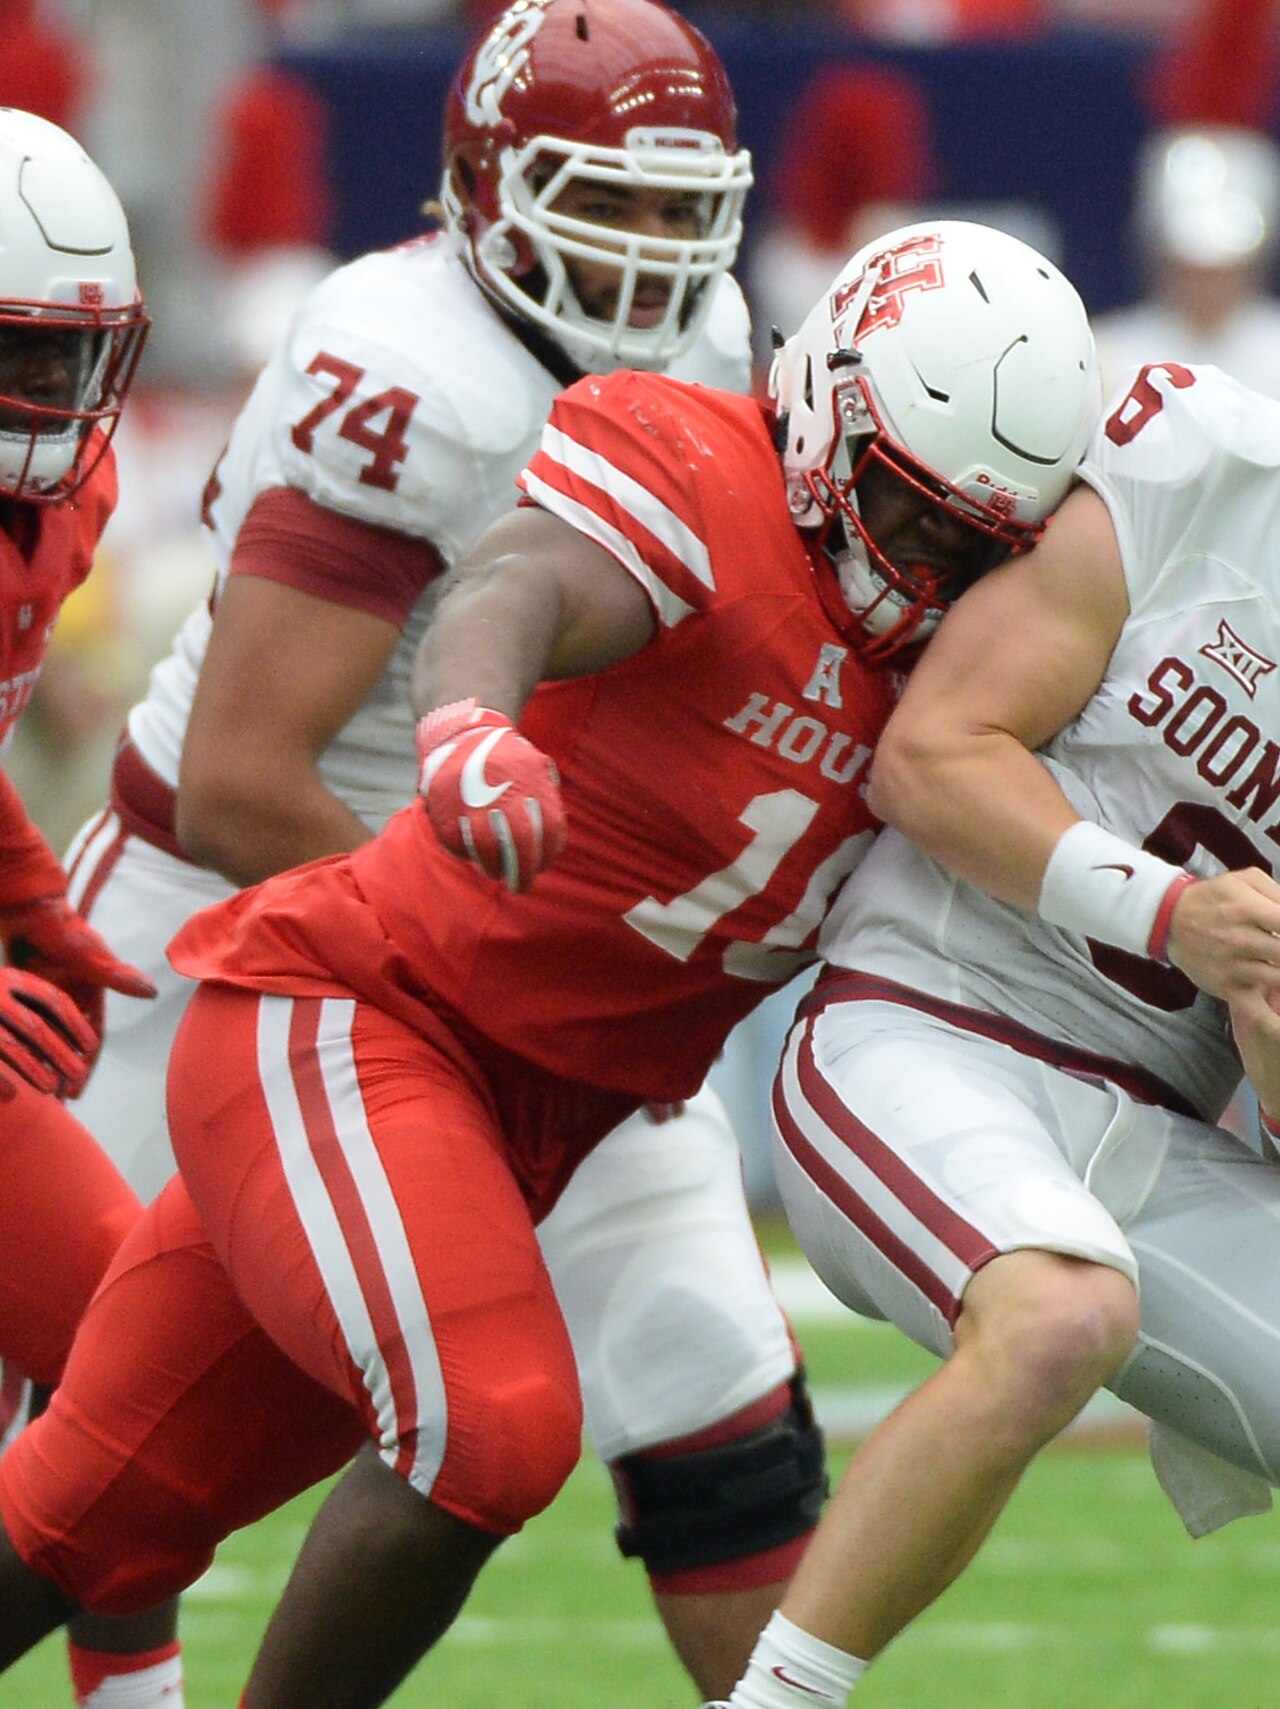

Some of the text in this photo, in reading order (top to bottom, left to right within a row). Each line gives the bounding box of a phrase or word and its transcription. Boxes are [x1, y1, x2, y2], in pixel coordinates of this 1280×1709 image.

[291, 350, 420, 493] 74
[1104, 362, 1197, 447] 6
[802, 642, 848, 709] A
[723, 692, 875, 800] HOU
